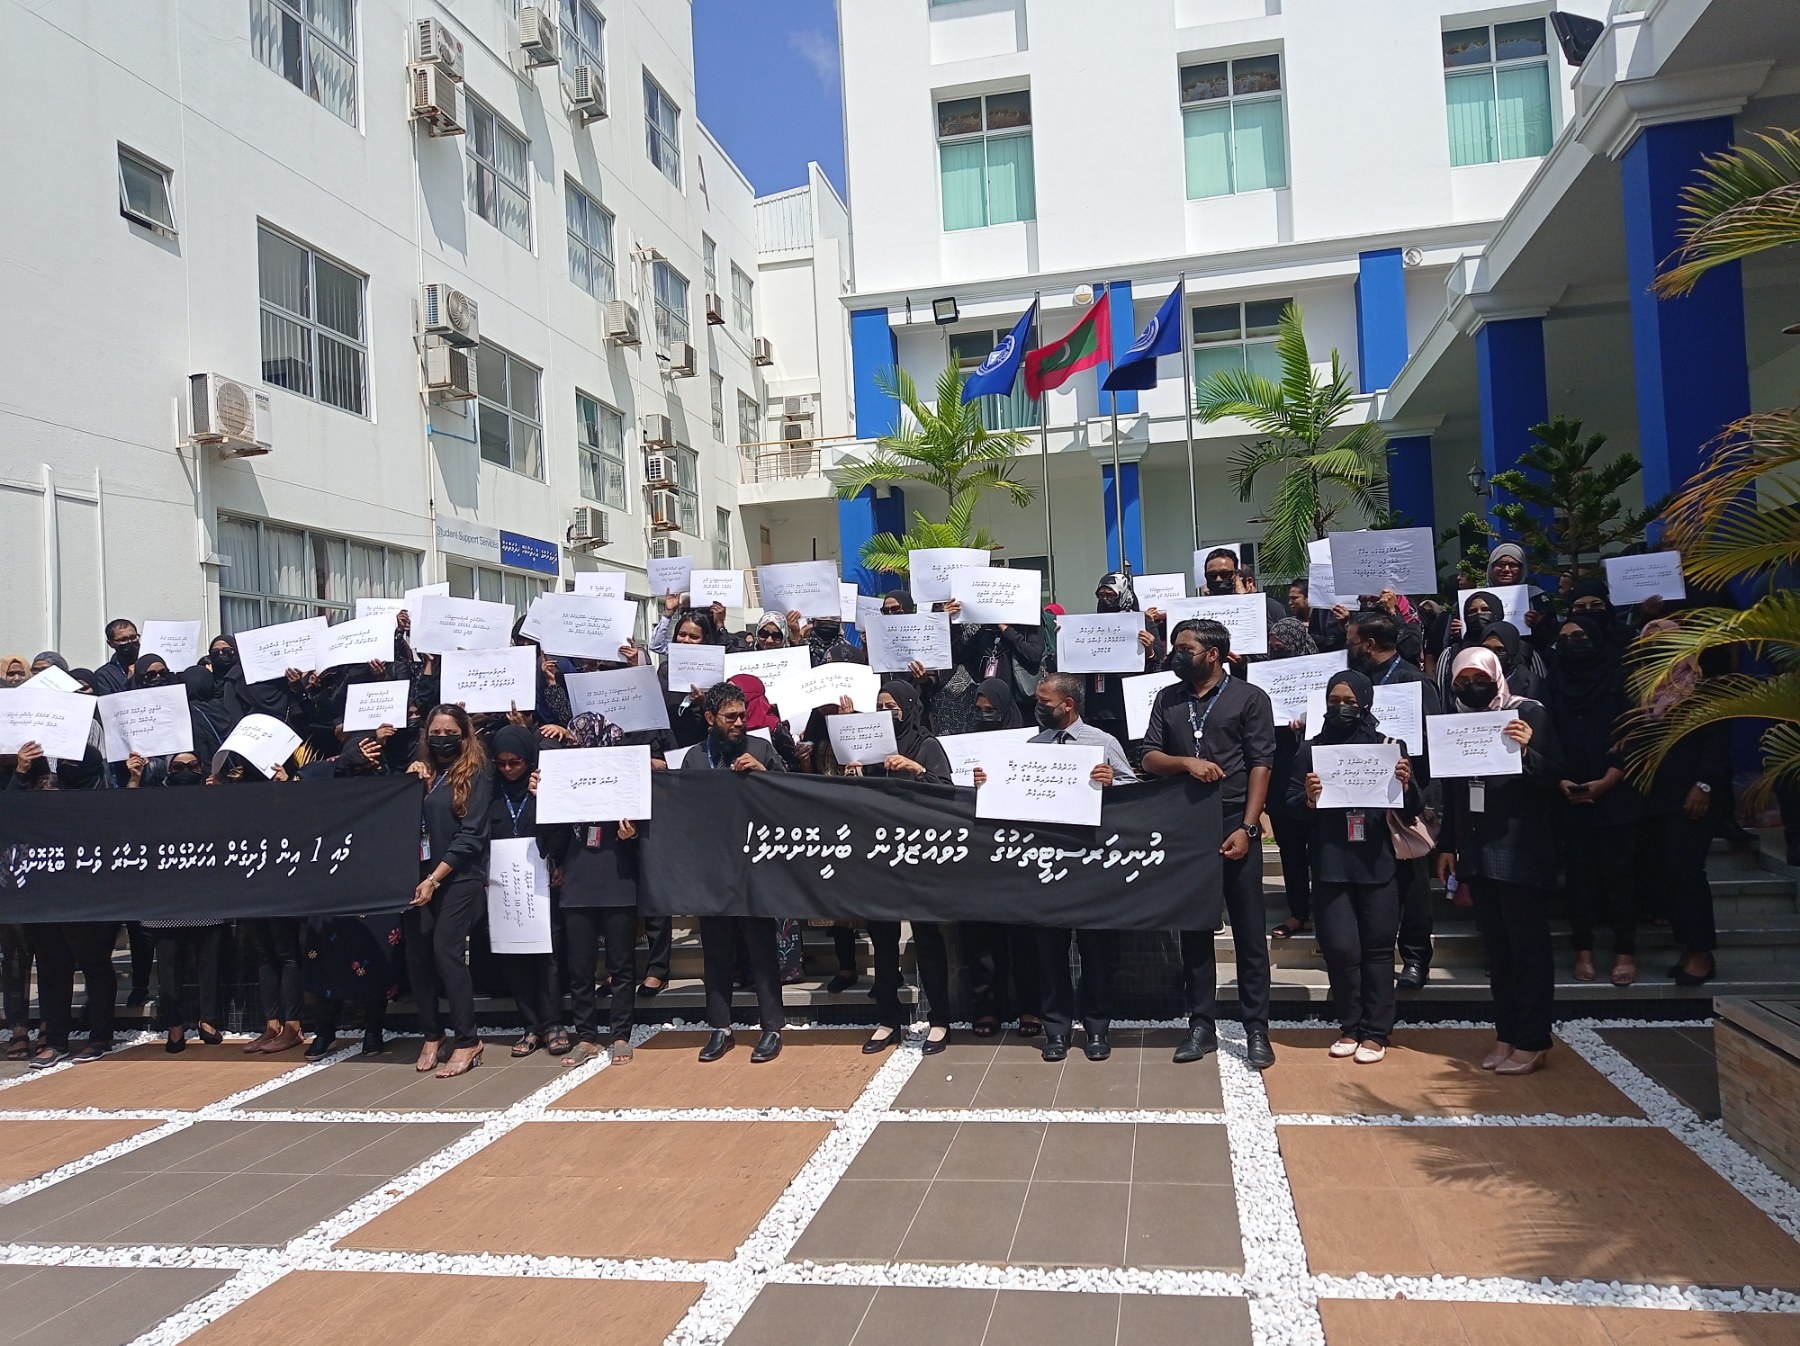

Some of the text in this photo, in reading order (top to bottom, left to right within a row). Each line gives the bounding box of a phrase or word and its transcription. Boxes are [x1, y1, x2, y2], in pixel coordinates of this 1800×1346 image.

[436, 526, 499, 549] Student Support Services
[600, 777, 618, 785] މުސާރަ
[1034, 775, 1063, 786] މުސާރައިން
[76, 846, 102, 874] ވެސް
[111, 843, 148, 871] މުސާރަ
[225, 839, 267, 878] ފެށިގެން
[276, 838, 301, 877] އިން
[310, 837, 322, 862] 1
[329, 833, 353, 874] މެއި
[867, 828, 969, 867] މުވައްޒަފުން
[990, 829, 1165, 884] ޔުނިވަރސިޓީތަކުގެ
